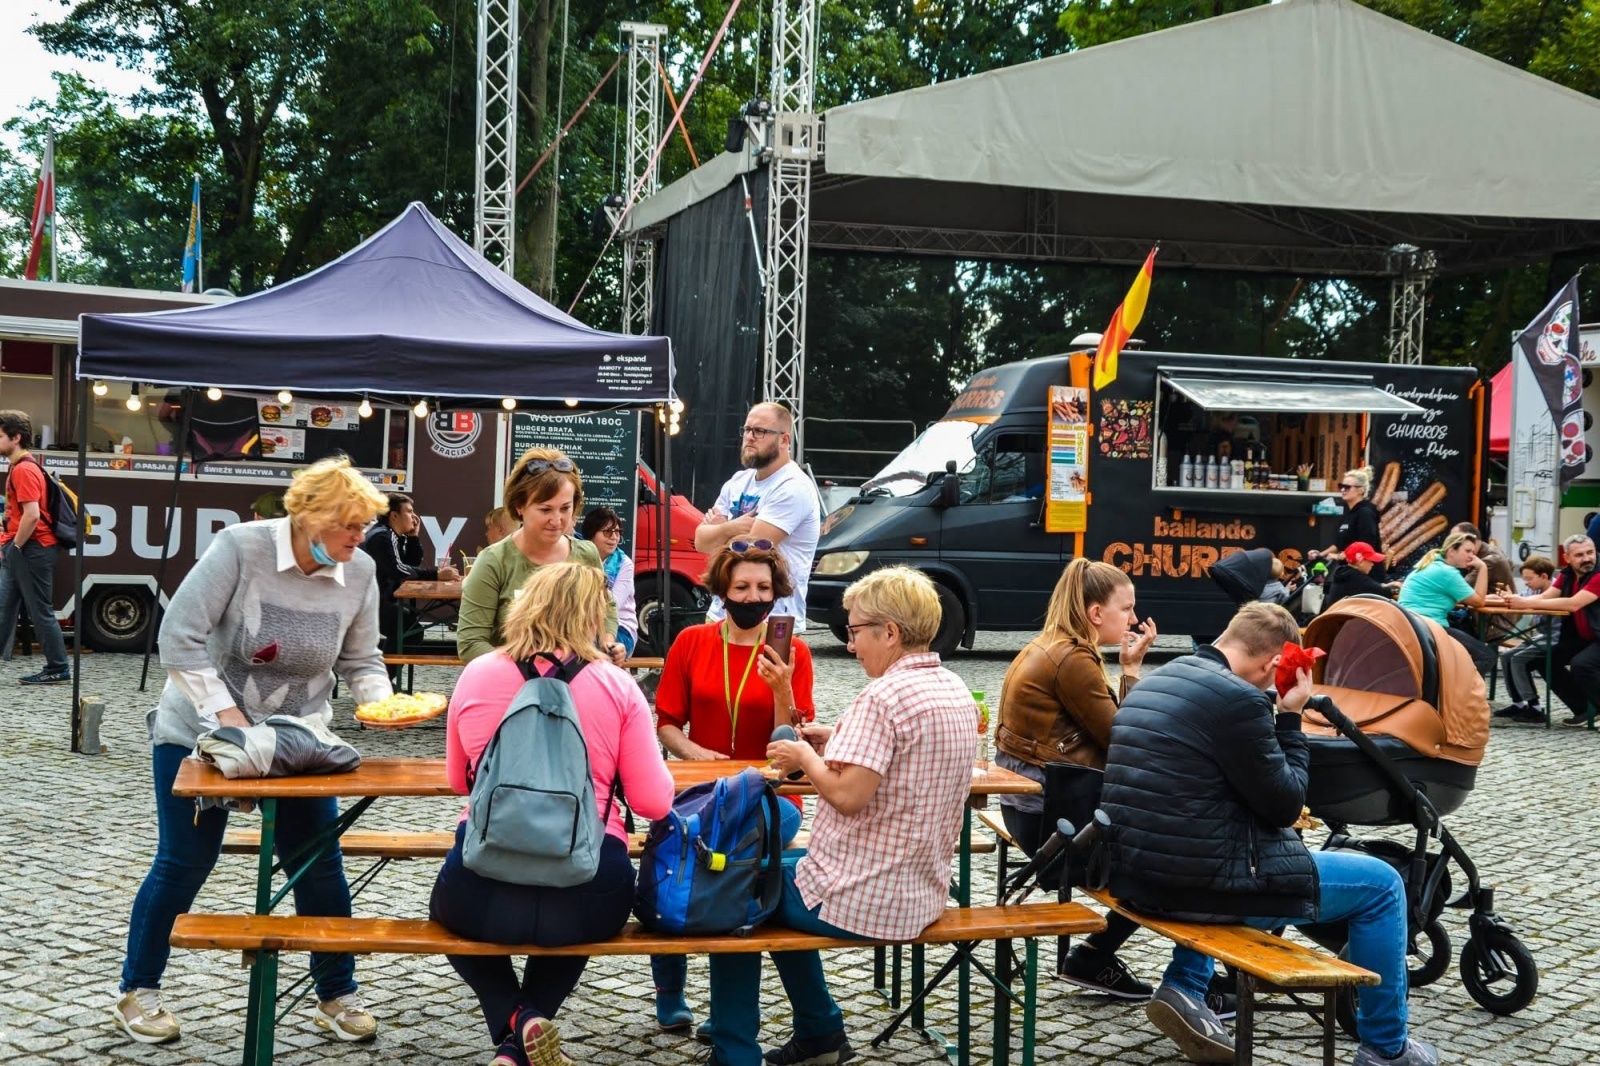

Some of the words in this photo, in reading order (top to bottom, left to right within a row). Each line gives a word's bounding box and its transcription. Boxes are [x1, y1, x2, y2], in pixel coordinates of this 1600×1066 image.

[616, 354, 647, 364] ekspand
[530, 414, 594, 425] WOŁOWINA
[596, 417, 623, 426] 180G
[1386, 423, 1448, 440] CHURROS
[45, 459, 79, 467] OPIEKAN
[142, 463, 167, 471] PASJA
[203, 465, 233, 475] ŚWIEŻE
[234, 468, 274, 476] WARZYWA
[1154, 516, 1256, 540] bailando
[1102, 542, 1303, 580] CHURS
